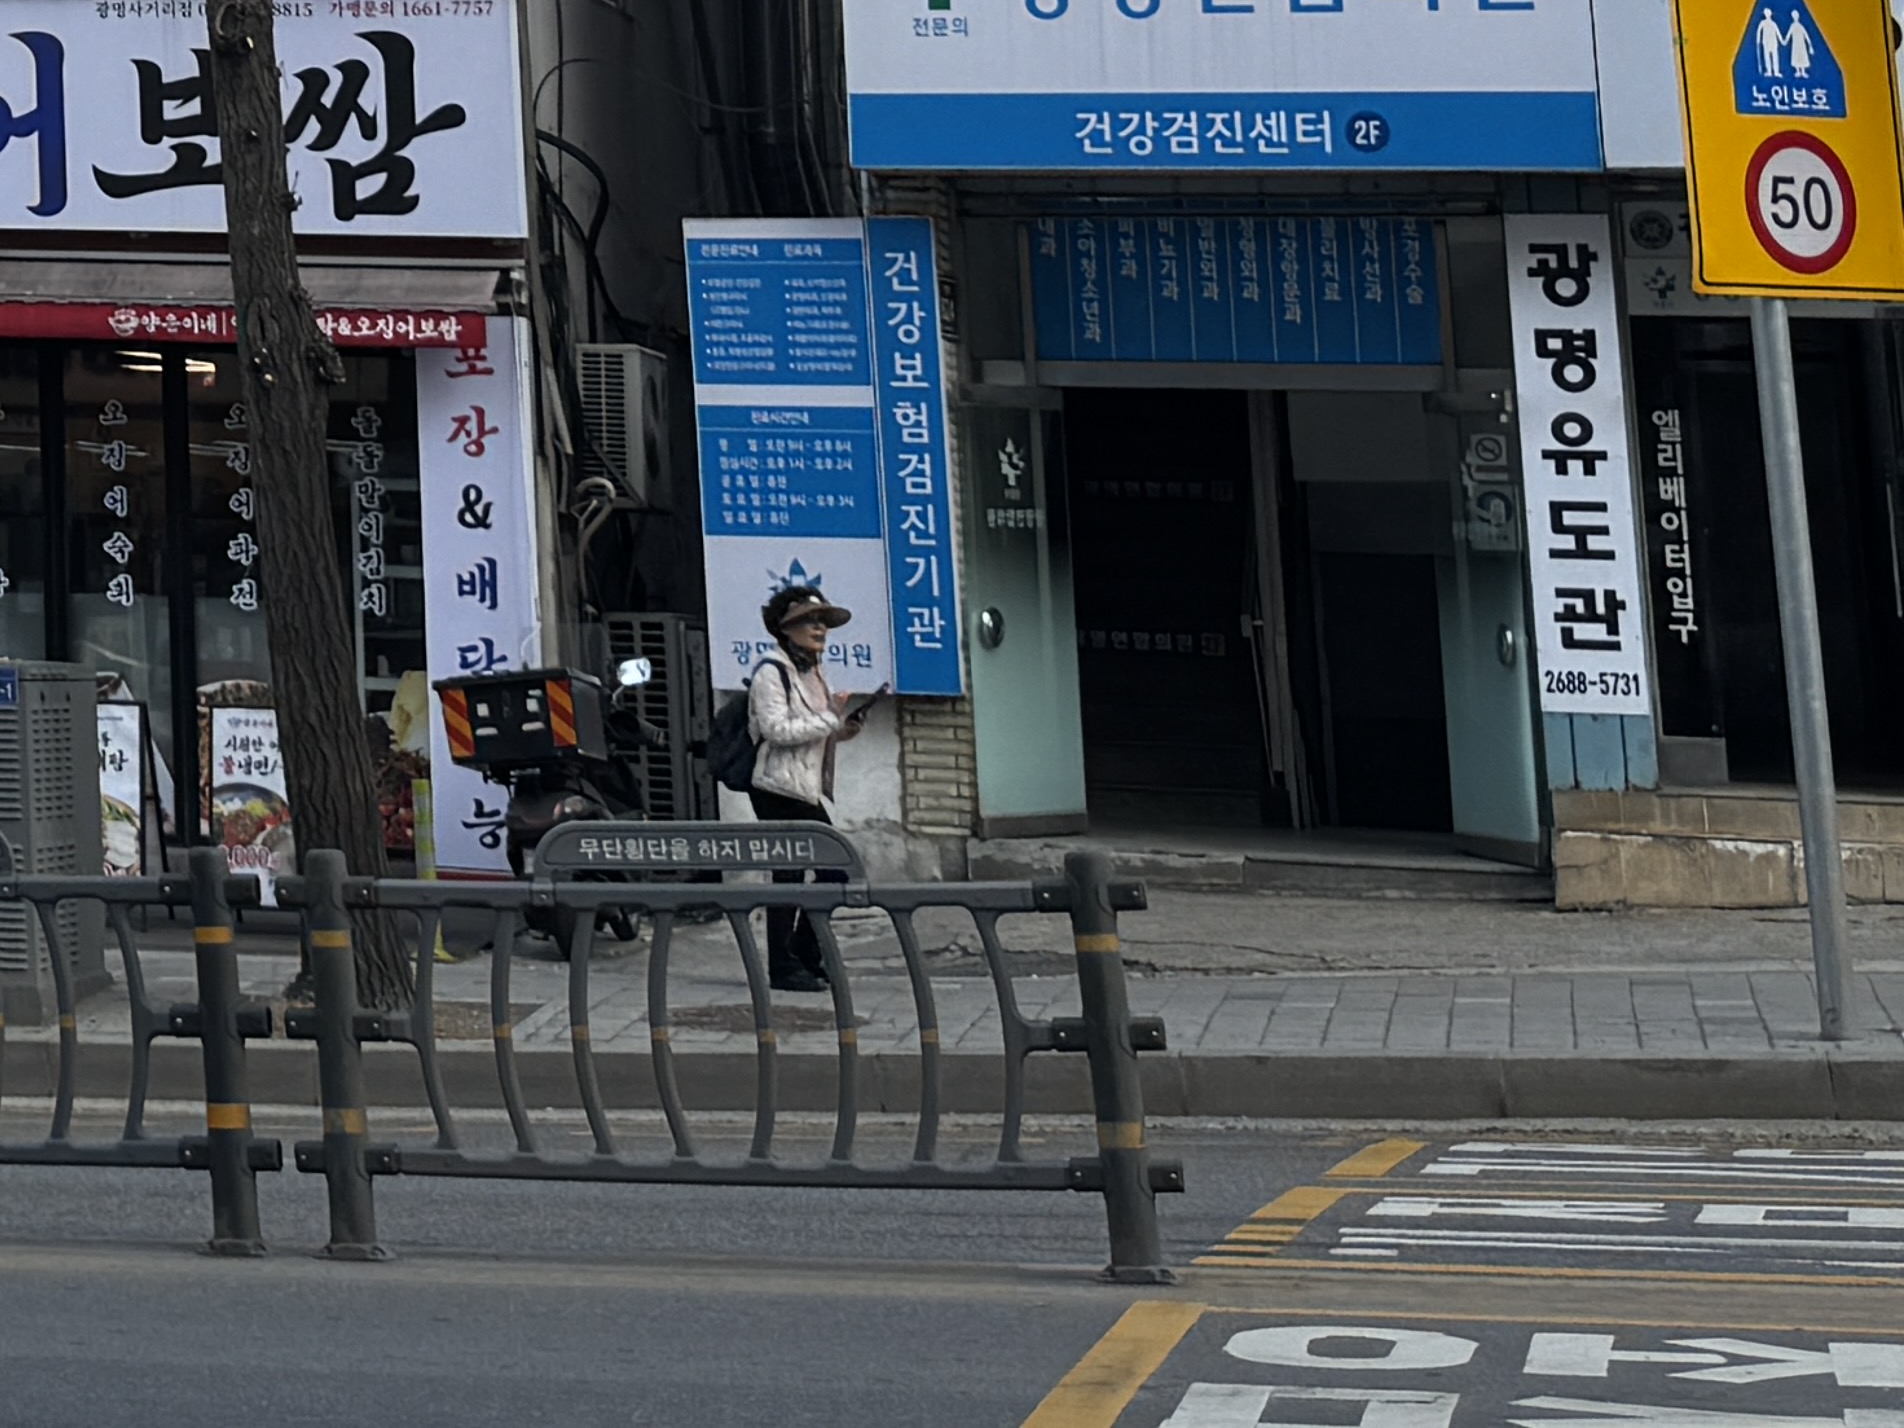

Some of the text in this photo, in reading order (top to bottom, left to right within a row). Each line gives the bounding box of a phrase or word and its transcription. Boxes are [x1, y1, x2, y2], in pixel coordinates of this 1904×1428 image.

[94, 0, 193, 20] 광명사거리점
[327, 0, 396, 19] 가맹문의
[400, 0, 494, 18] 1661-7757
[911, 16, 970, 39] 전문의
[1751, 84, 1832, 112] 노인보호
[1073, 110, 1383, 158] 건강검진센터 2F
[1768, 173, 1834, 233] 50
[139, 312, 217, 336] 양은이네
[882, 249, 946, 651] 건강보험검진기관
[1527, 241, 1626, 652] 광명유도관
[1651, 408, 1699, 646] 엘리베이터입구
[1543, 671, 1641, 698] 2688-5731
[577, 835, 816, 864] 무단횡단을 하지 맙시다
